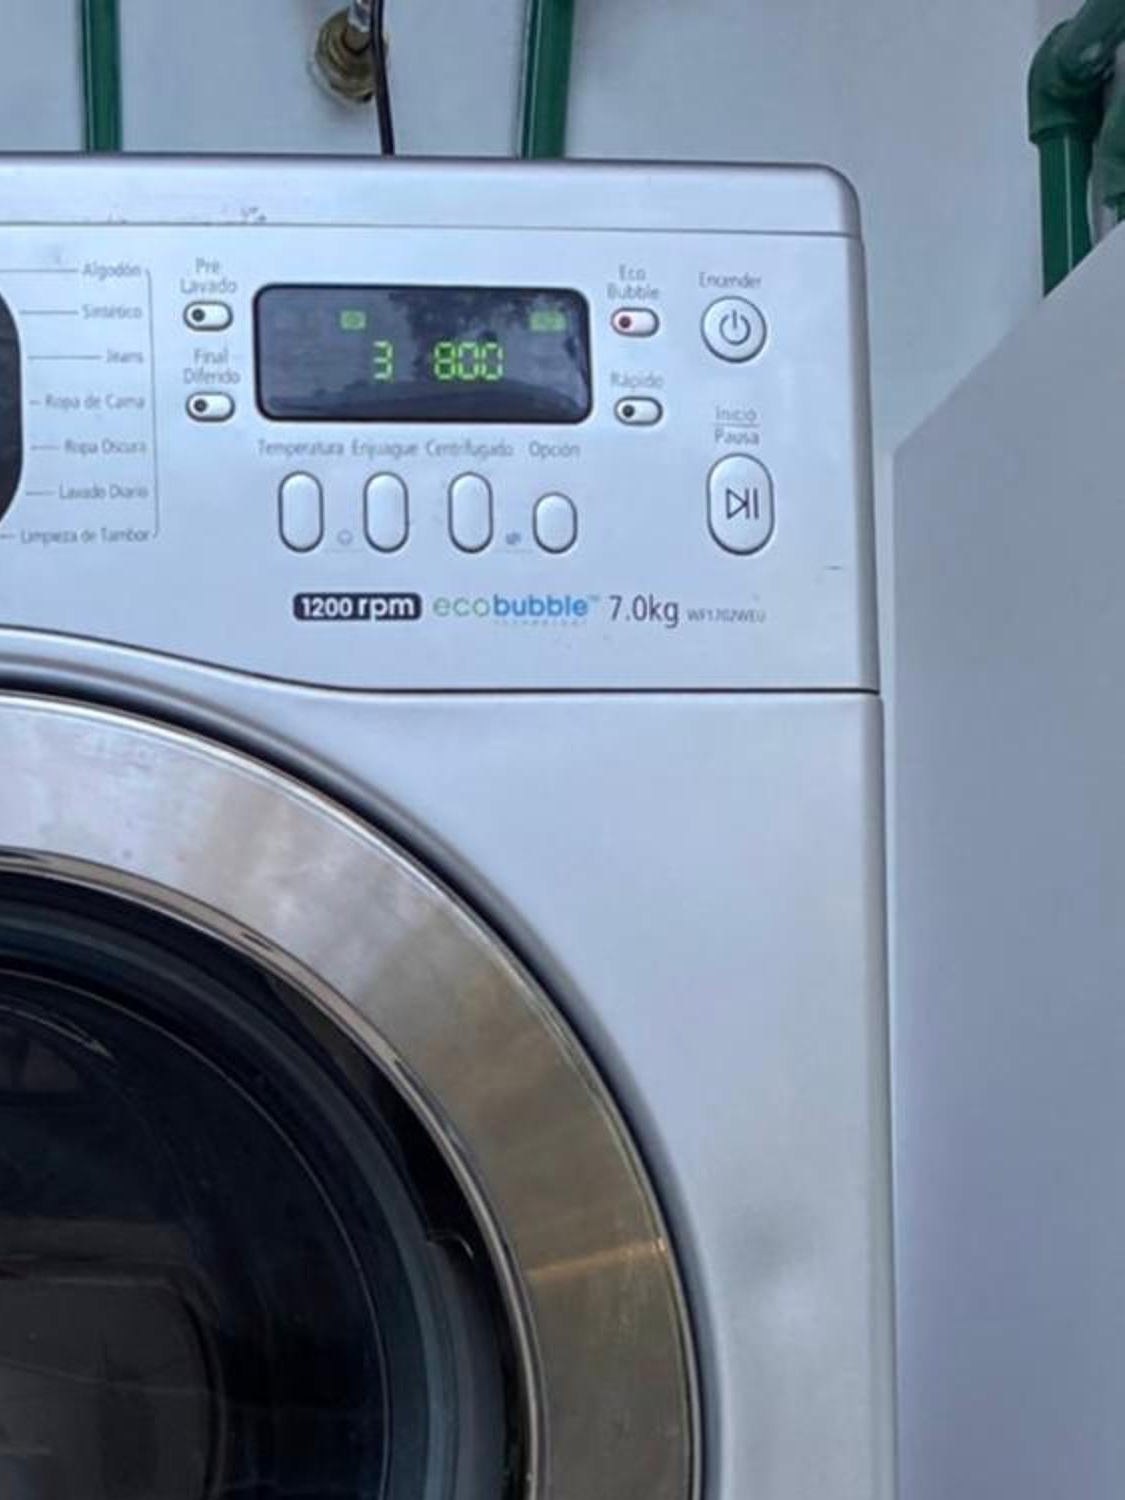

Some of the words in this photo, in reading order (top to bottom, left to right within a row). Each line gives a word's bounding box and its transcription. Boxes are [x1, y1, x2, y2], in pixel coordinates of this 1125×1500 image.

[619, 264, 647, 282] Eco
[179, 277, 239, 295] Lavado
[607, 282, 660, 300] Bubble
[106, 349, 144, 364] Jeans
[193, 346, 229, 365] Final
[373, 340, 393, 381] 3
[434, 340, 504, 381] 800
[183, 366, 242, 385] Diferido
[44, 394, 81, 412] Ropa
[84, 394, 102, 409] de
[105, 394, 146, 410] Cama
[714, 428, 760, 446] Pausa
[64, 438, 99, 457] Ropa
[102, 438, 148, 455] Oscura
[257, 438, 344, 458] Temperatura
[351, 438, 420, 458] Enjuague
[425, 438, 515, 458] Centrifugado
[528, 437, 582, 459] Opción
[58, 479, 106, 500] Lavado
[109, 483, 149, 500] Diario
[20, 530, 78, 548] Limpieza
[80, 528, 96, 544] de
[101, 527, 150, 543] Tambor
[300, 597, 352, 617] 1200
[358, 597, 415, 620] rpm
[432, 594, 589, 618] ecobubble
[608, 594, 680, 629] 7.0kg
